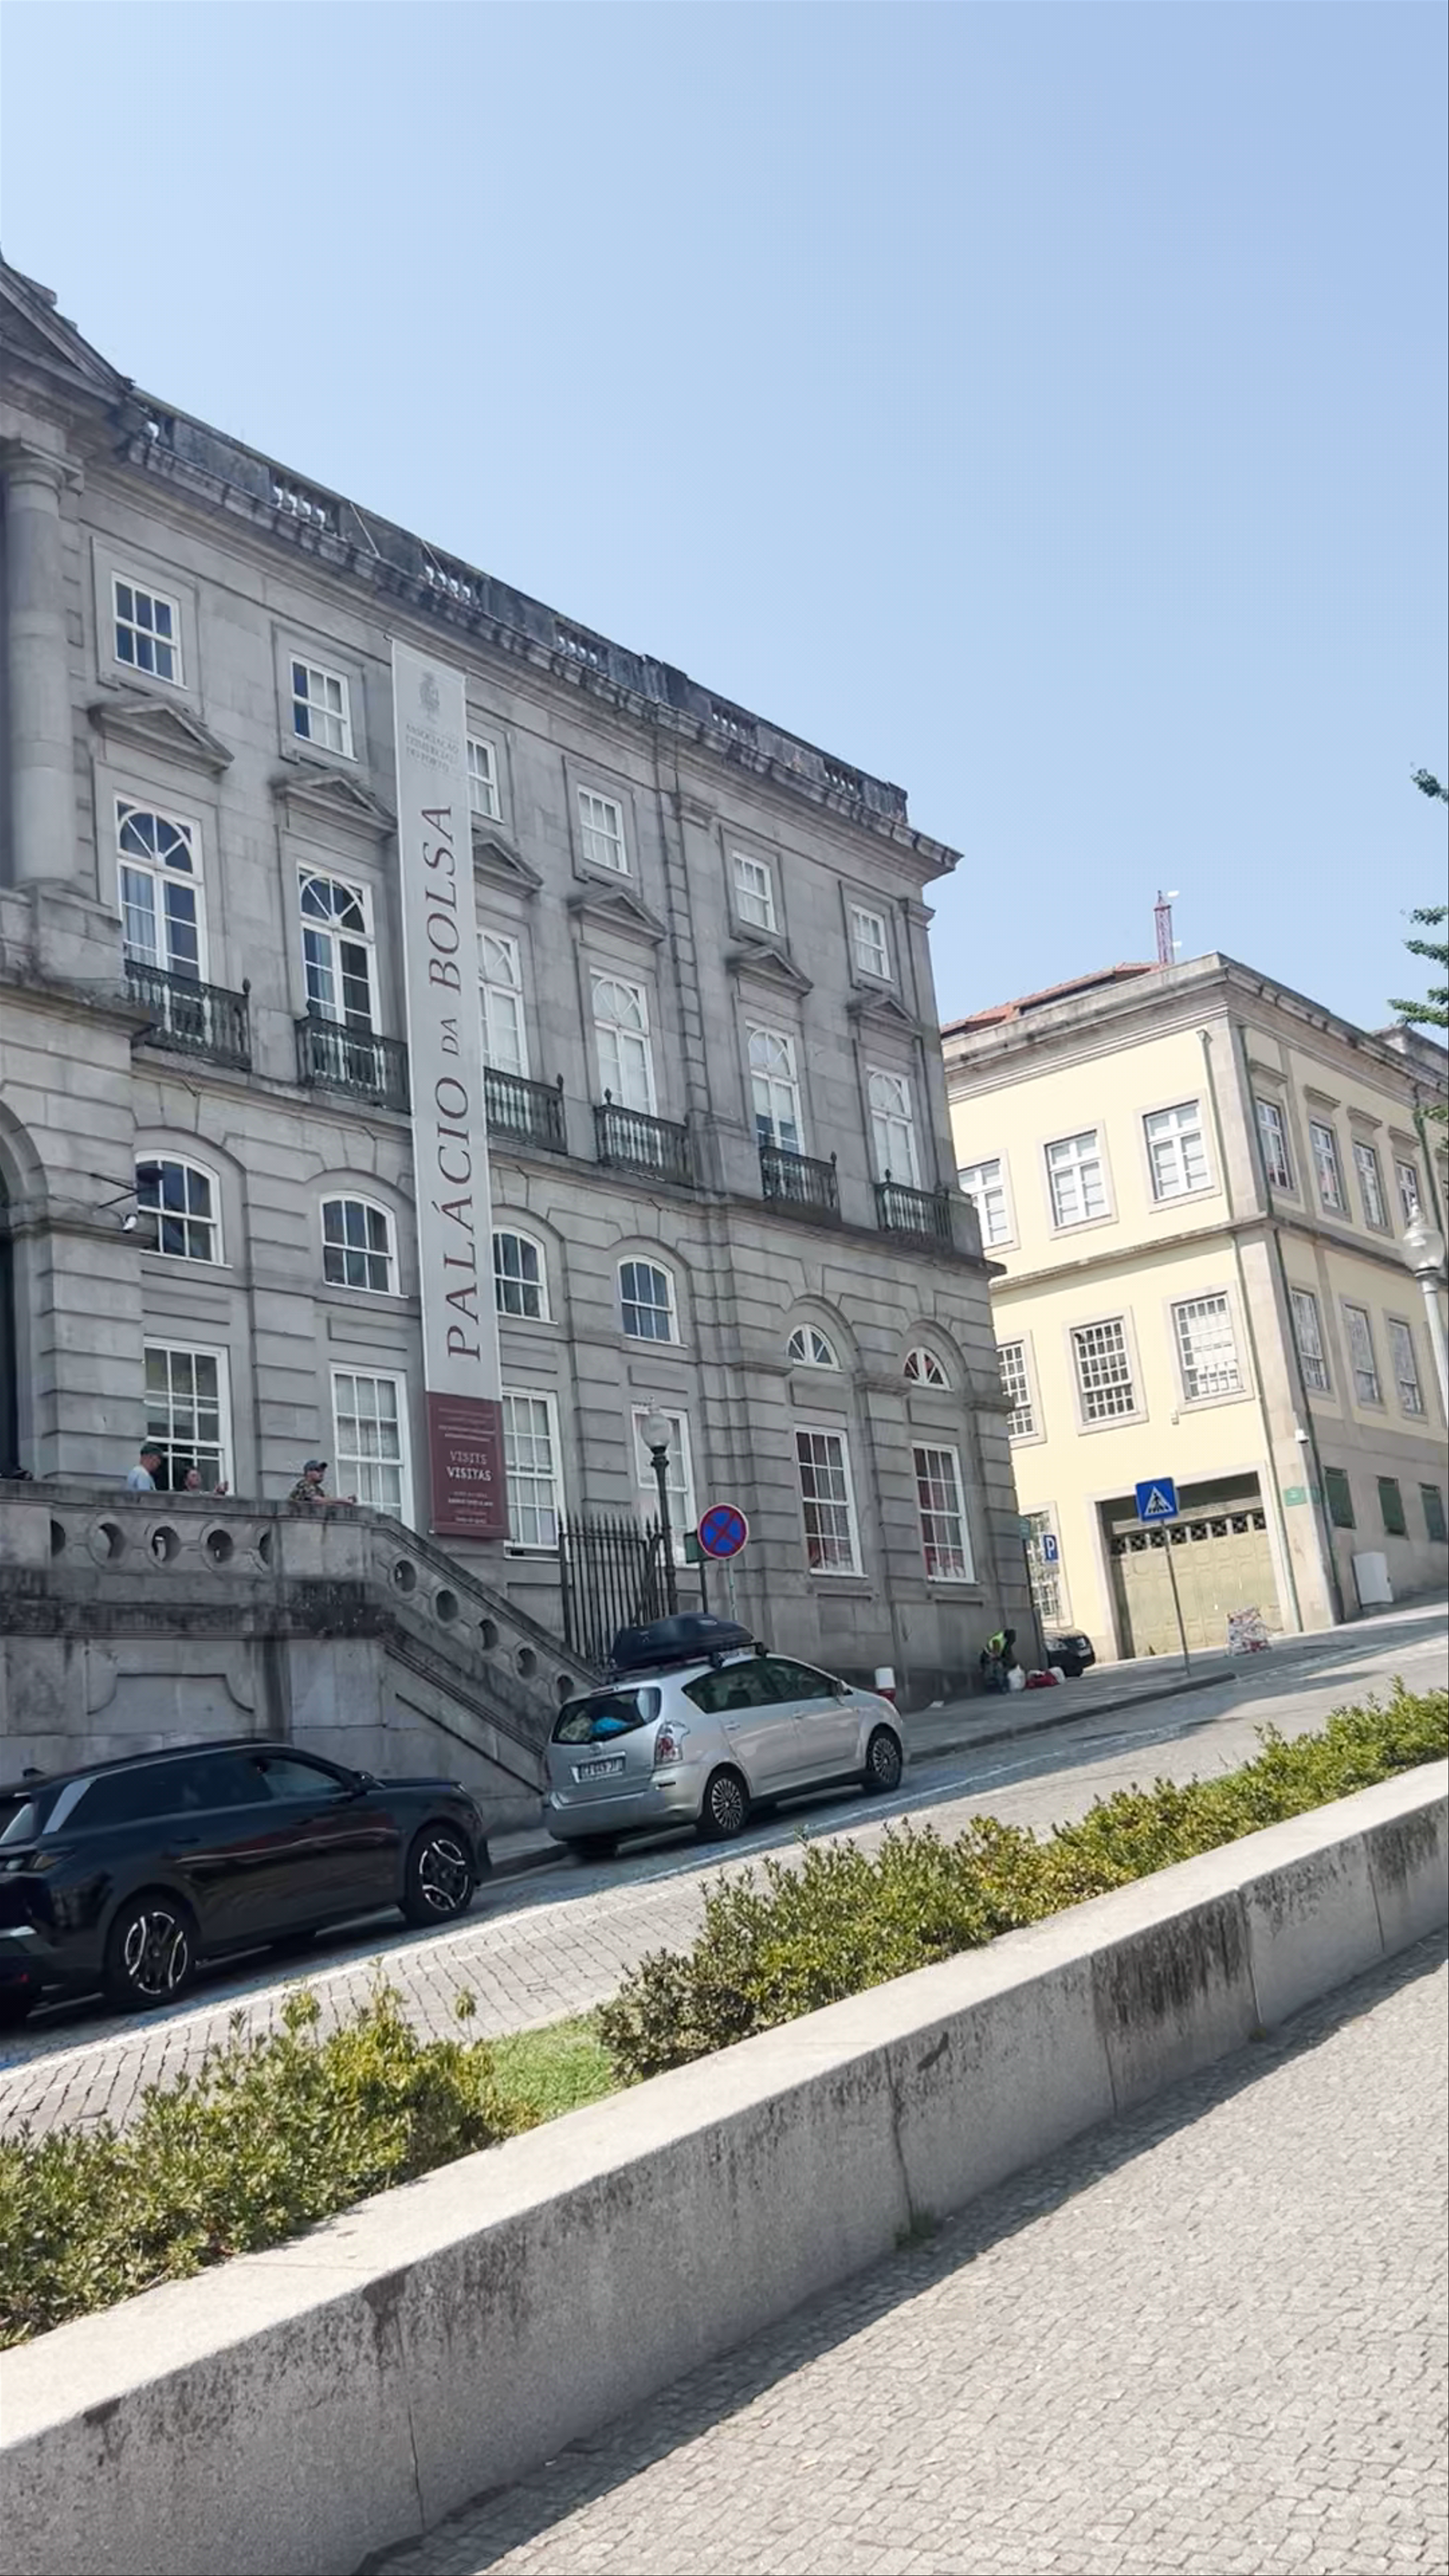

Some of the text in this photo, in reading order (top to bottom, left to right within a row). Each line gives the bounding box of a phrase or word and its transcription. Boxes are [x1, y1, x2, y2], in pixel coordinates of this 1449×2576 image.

[421, 806, 461, 995] BOLSA
[441, 1018, 460, 1056] DA
[431, 1077, 481, 1361] PALÁCIO
[446, 1466, 492, 1481] VISITAS
[1046, 1536, 1055, 1559] P
